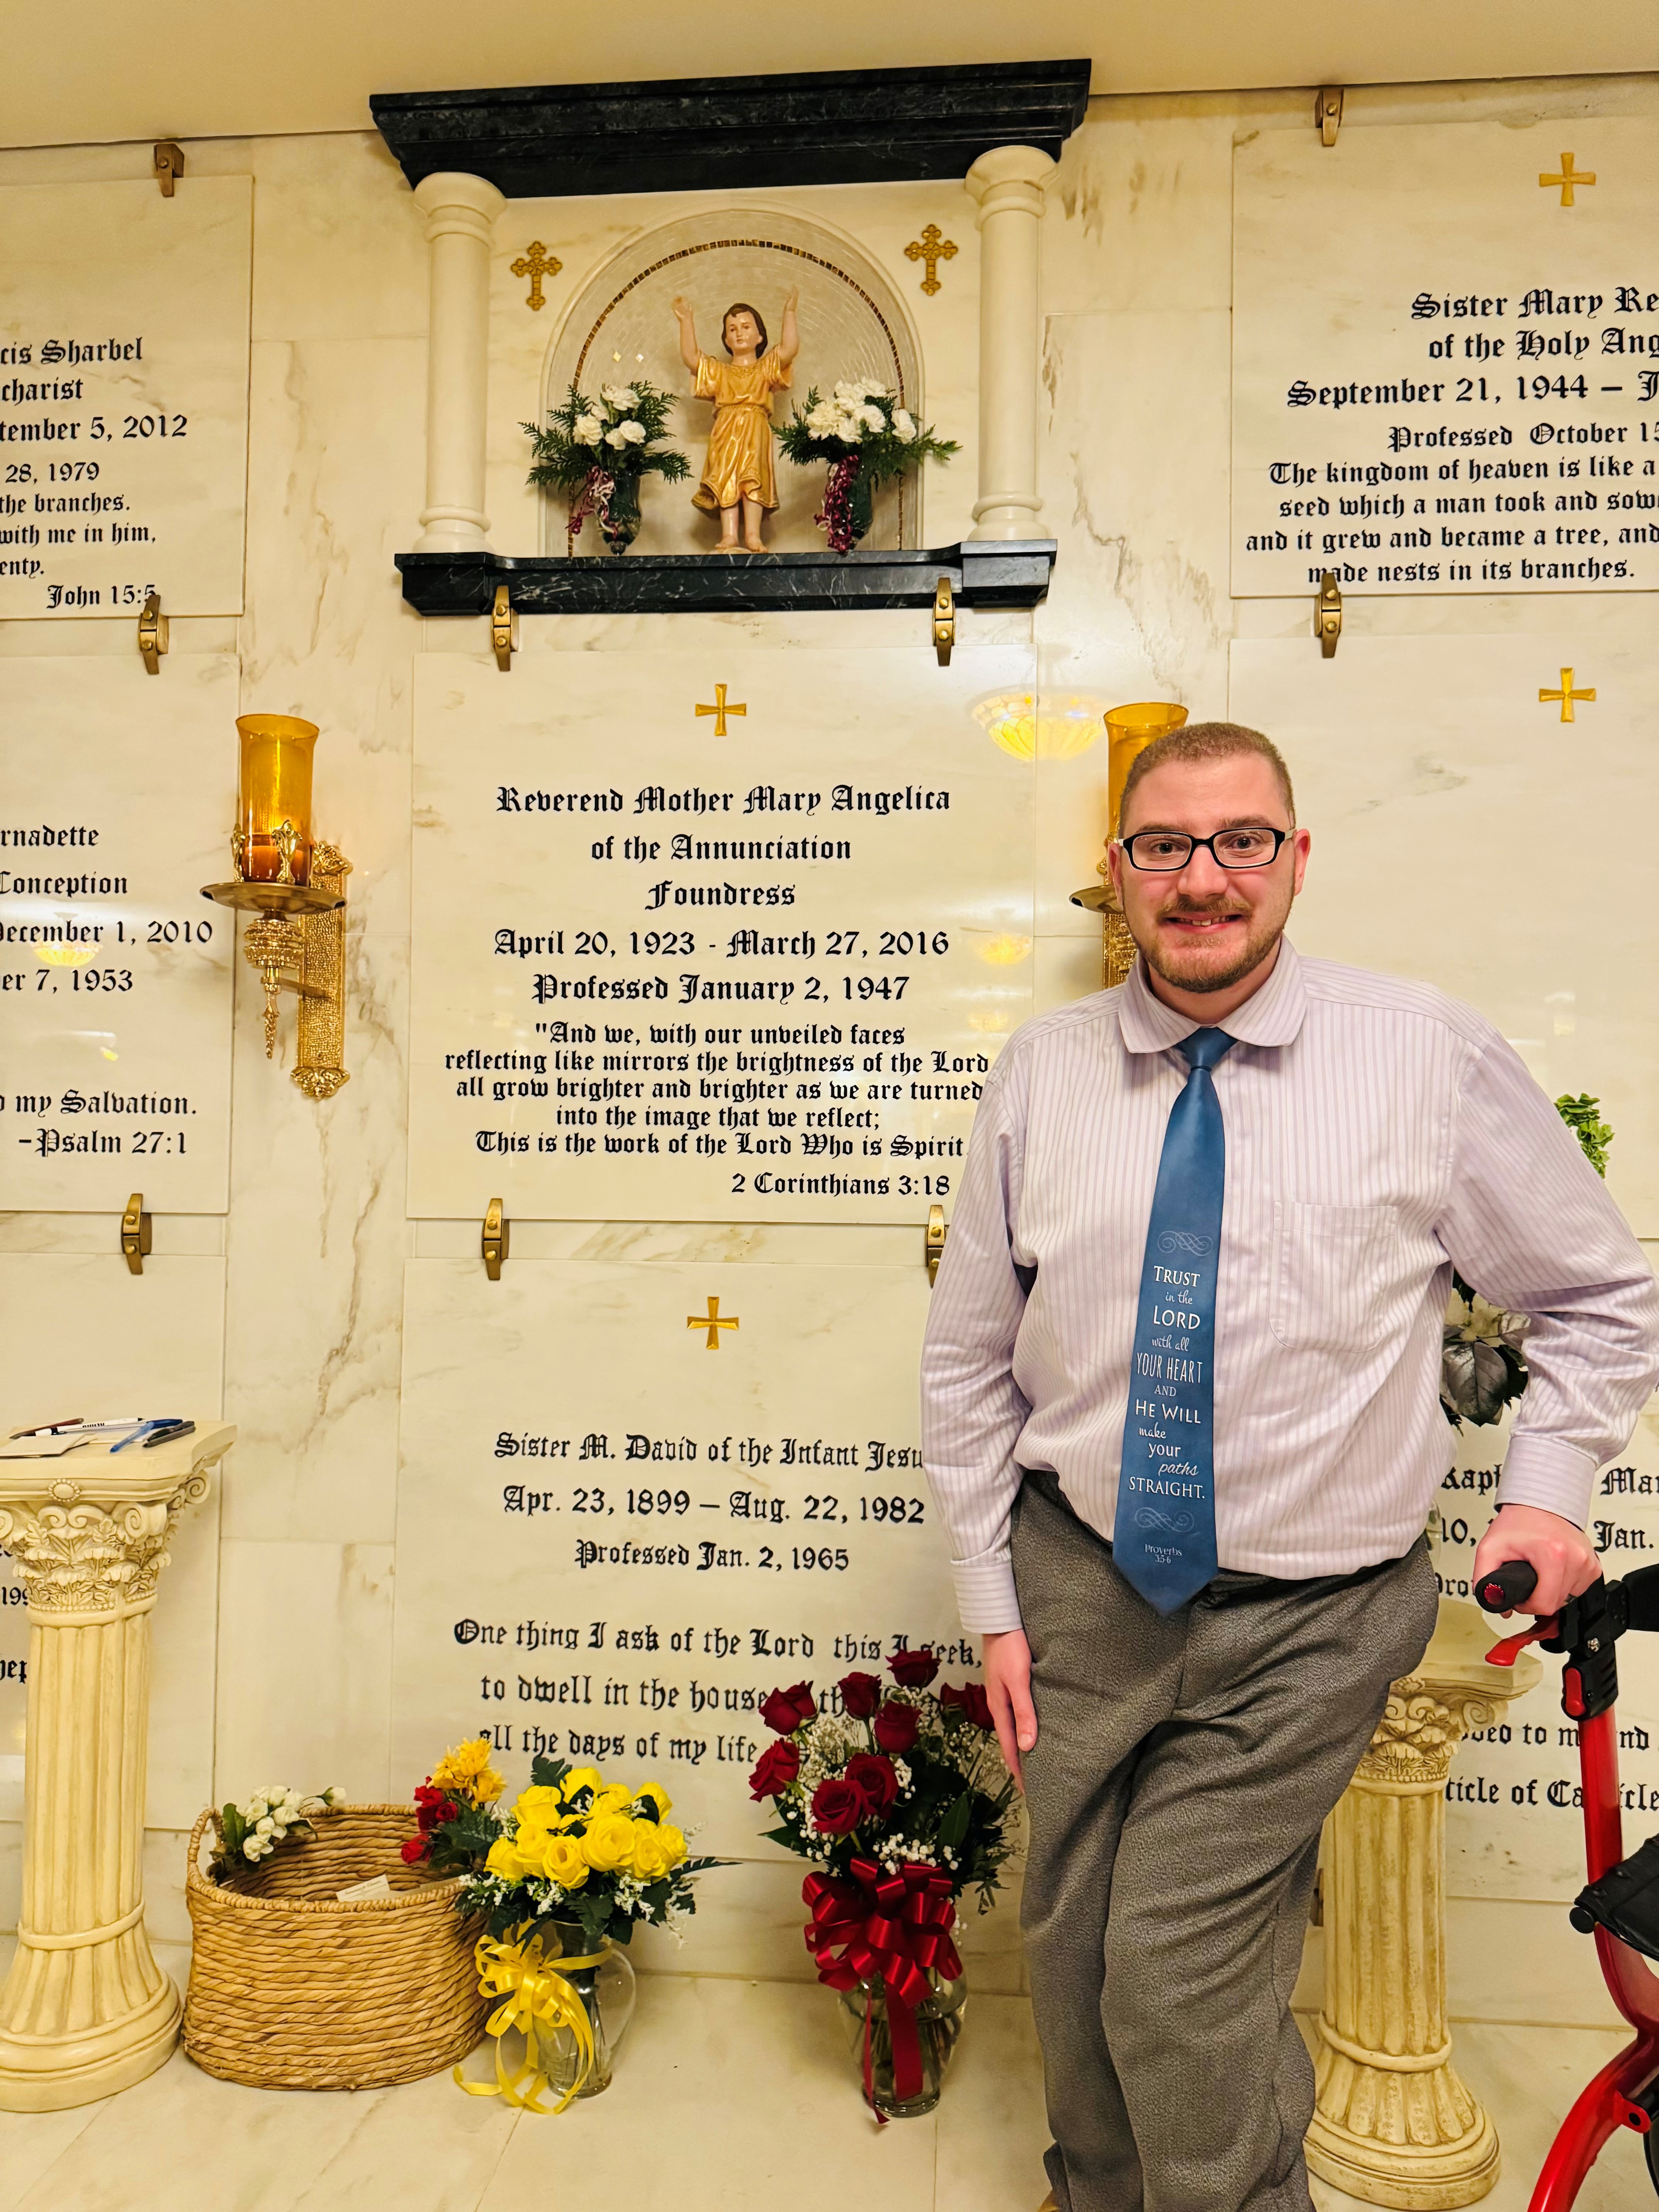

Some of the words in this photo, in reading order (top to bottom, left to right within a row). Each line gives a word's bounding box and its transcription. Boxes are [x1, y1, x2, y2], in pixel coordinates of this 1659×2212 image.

[1411, 292, 1508, 320] Sister
[1518, 289, 1603, 319] Mary
[40, 337, 143, 367] Sharbel
[1429, 333, 1455, 359] of
[1464, 333, 1505, 363] the
[1516, 330, 1590, 361] Holy
[2, 377, 84, 406] charist
[1287, 378, 1445, 410] September
[1456, 377, 1501, 404] 21,
[1516, 374, 1589, 400] 1944
[90, 416, 112, 442] 5,
[122, 414, 187, 438] 2012
[1387, 425, 1512, 453] Professed
[1530, 422, 1628, 445] October
[5, 464, 38, 484] 28,
[49, 462, 100, 482] 1979
[1269, 462, 1317, 488] The
[1327, 461, 1428, 486] kingdom
[1438, 459, 1460, 480] of
[1469, 459, 1549, 484] heaven
[1559, 456, 1580, 477] is
[1590, 455, 1634, 477] like
[1643, 460, 1656, 476] a
[34, 492, 130, 515] branches.
[48, 529, 76, 543] me
[84, 523, 103, 543] in
[112, 522, 156, 545] him,
[1246, 530, 1287, 551] and
[1297, 529, 1313, 550] it
[1322, 529, 1381, 554] grew
[1389, 527, 1431, 548] and
[1441, 526, 1525, 547] became
[1534, 529, 1546, 545] a
[1556, 526, 1608, 547] tree,
[1377, 562, 1440, 582] nests
[1449, 560, 1472, 580] in
[1482, 561, 1512, 580] its
[1521, 556, 1635, 582] branches.
[46, 585, 100, 609] John
[496, 787, 623, 812] Reverend
[633, 786, 734, 816] Mother
[743, 785, 821, 816] Mary
[831, 784, 950, 816] Angelica
[591, 835, 615, 860] of
[623, 835, 661, 864] the
[671, 834, 851, 860] Annunciation
[644, 880, 795, 910] Foundress
[117, 921, 136, 945] 1,
[147, 921, 213, 943] 2010
[495, 929, 564, 959] April
[574, 931, 616, 958] 20,
[630, 931, 695, 955] 1923
[726, 929, 815, 960] March
[825, 931, 867, 958] 27,
[879, 931, 949, 955] 2016
[2, 974, 26, 991] er
[36, 969, 57, 994] 7,
[72, 969, 133, 992] 1953
[531, 974, 668, 1004] Professed
[678, 974, 794, 1005] January
[804, 976, 829, 1003] 2,
[843, 976, 910, 1000] 1947
[536, 1021, 596, 1043] "And
[605, 1024, 641, 1046] we,
[649, 1023, 696, 1048] with
[705, 1029, 742, 1044] our
[750, 1024, 842, 1044] unveiled
[850, 1024, 905, 1045] faces
[445, 1049, 547, 1074] reflecting
[555, 1050, 594, 1071] like
[603, 1051, 689, 1071] mirrors
[697, 1051, 728, 1075] the
[737, 1051, 855, 1076] brightness
[863, 1052, 883, 1072] of
[891, 1052, 923, 1077] the
[931, 1051, 988, 1073] Lord
[15, 1095, 52, 1118] my
[60, 1089, 196, 1115] Salvation.
[557, 1105, 597, 1125] into
[606, 1105, 637, 1130] the
[645, 1105, 711, 1130] image
[718, 1106, 760, 1130] that
[768, 1108, 797, 1127] we
[805, 1107, 879, 1130] reflect;
[132, 1131, 187, 1154] 27:1
[732, 1173, 745, 1193] 2
[754, 1172, 890, 1197] Corinthians
[898, 1175, 950, 1196] 3:18
[1165, 1292, 1175, 1302] in
[1178, 1290, 1193, 1304] the
[1153, 1305, 1200, 1329] LORD
[1152, 1334, 1172, 1349] with
[1175, 1337, 1189, 1351] all
[1137, 1352, 1162, 1379] YOUR
[1167, 1357, 1202, 1383] HEART
[1154, 1385, 1176, 1396] AND
[1136, 1399, 1156, 1418] HE
[1162, 1404, 1201, 1424] WILL
[1139, 1422, 1166, 1439] make
[494, 1432, 571, 1458] Sister
[579, 1433, 616, 1460] M.
[624, 1434, 697, 1461] David
[708, 1436, 732, 1462] of
[738, 1437, 773, 1467] the
[780, 1438, 859, 1466] Infant
[865, 1441, 923, 1472] Jesu
[1149, 1443, 1181, 1458] your
[1158, 1462, 1199, 1476] paths
[1129, 1477, 1205, 1499] STRAIGHT.
[503, 1485, 560, 1516] Apr.
[572, 1487, 614, 1516] 23,
[627, 1489, 690, 1515] 1899
[730, 1491, 790, 1524] Aug.
[803, 1494, 848, 1524] 22,
[860, 1496, 924, 1524] 1982
[574, 1539, 689, 1569] Professed
[696, 1541, 750, 1571] Jan.
[758, 1546, 782, 1571] 2,
[792, 1547, 849, 1571] 1965
[1145, 1544, 1182, 1556] Proverbs
[454, 1618, 507, 1645] One
[516, 1620, 579, 1651] thing
[587, 1622, 607, 1649] I
[616, 1625, 660, 1652] ask
[671, 1627, 694, 1652] of
[704, 1628, 741, 1658] the
[749, 1628, 813, 1658] Lord
[833, 1633, 882, 1663] this
[522, 1726, 559, 1757] the
[568, 1729, 625, 1762] days
[636, 1732, 660, 1758] of
[669, 1738, 707, 1765] my
[717, 1735, 758, 1763] life
[1511, 1779, 1538, 1806] of
